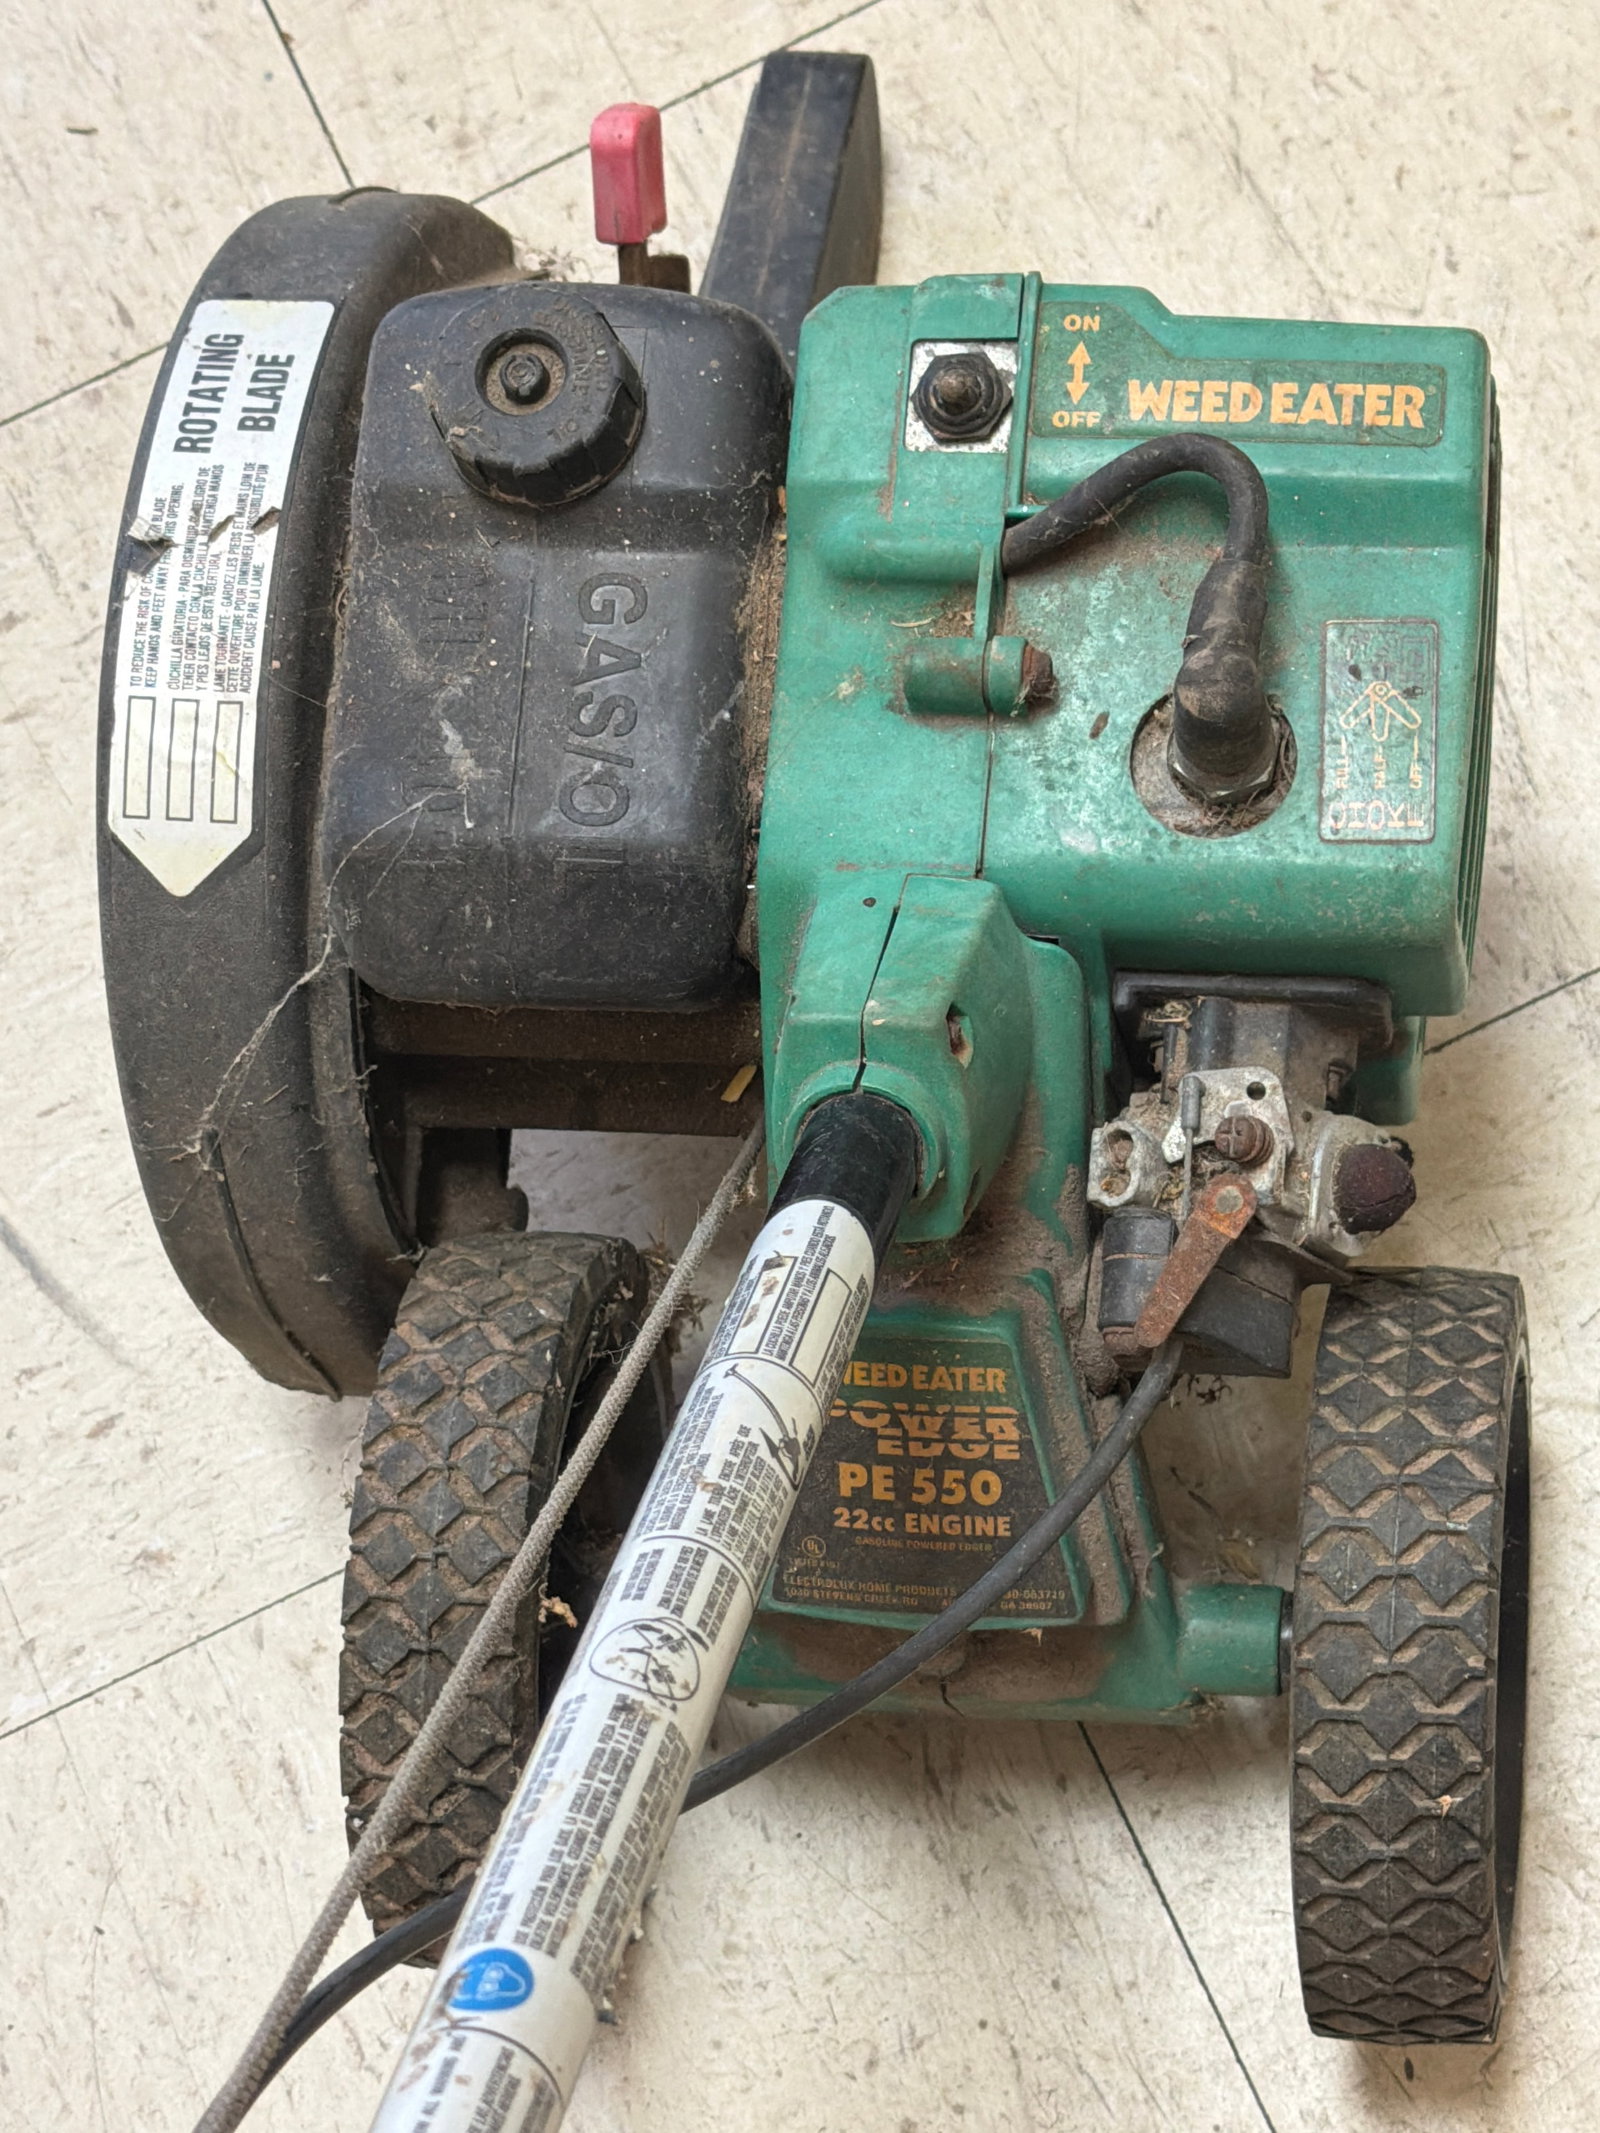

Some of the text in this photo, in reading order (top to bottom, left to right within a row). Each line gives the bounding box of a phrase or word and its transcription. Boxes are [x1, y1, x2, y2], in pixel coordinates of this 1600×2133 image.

[1063, 313, 1100, 332] ON
[173, 333, 245, 454] ROTATING
[237, 354, 295, 432] BLADE
[1128, 379, 1426, 429] WEED EATER
[1052, 410, 1100, 428] OFF
[197, 466, 210, 477] DE
[208, 464, 224, 492] MANOS
[242, 461, 256, 471] DE
[151, 497, 167, 522] BLADE
[166, 484, 183, 518] OPENING.
[200, 493, 217, 536] MANTENGA
[231, 518, 244, 530] ET
[181, 525, 198, 567] DISMINUIR
[227, 531, 242, 555] PIEDS
[225, 556, 238, 572] LES
[139, 585, 151, 595] OF
[155, 566, 168, 590] AWAY
[178, 570, 191, 592] PARA
[151, 593, 165, 612] FEET
[220, 574, 235, 607] GARDEZ
[233, 587, 247, 611] POUR
[248, 588, 261, 600] LA
[136, 599, 149, 618] RISK
[201, 598, 214, 619] ESTA
[246, 601, 258, 619] PAR
[134, 621, 147, 636] THE
[149, 614, 162, 632] AND
[146, 634, 160, 664] HANDS
[184, 615, 198, 660] CONTACTO
[197, 635, 210, 662] LEJOS
[228, 614, 244, 664] OUVERTURE
[130, 639, 145, 673] REDUCE
[129, 675, 142, 686] TO
[144, 666, 157, 688] KEEP
[181, 662, 195, 690] TENER
[195, 663, 209, 683] PIES
[213, 668, 226, 692] LAME
[225, 666, 239, 693] CETTE
[239, 651, 253, 693] ACCIDENT
[843, 1361, 1007, 1393] EED EATER
[877, 1428, 1021, 1460] EDGE
[838, 1461, 1002, 1506] PE 550
[833, 1506, 1011, 1537] 22cc ENGINE
[858, 1580, 892, 1592] HOME
[895, 1584, 956, 1595] PRODUCTS
